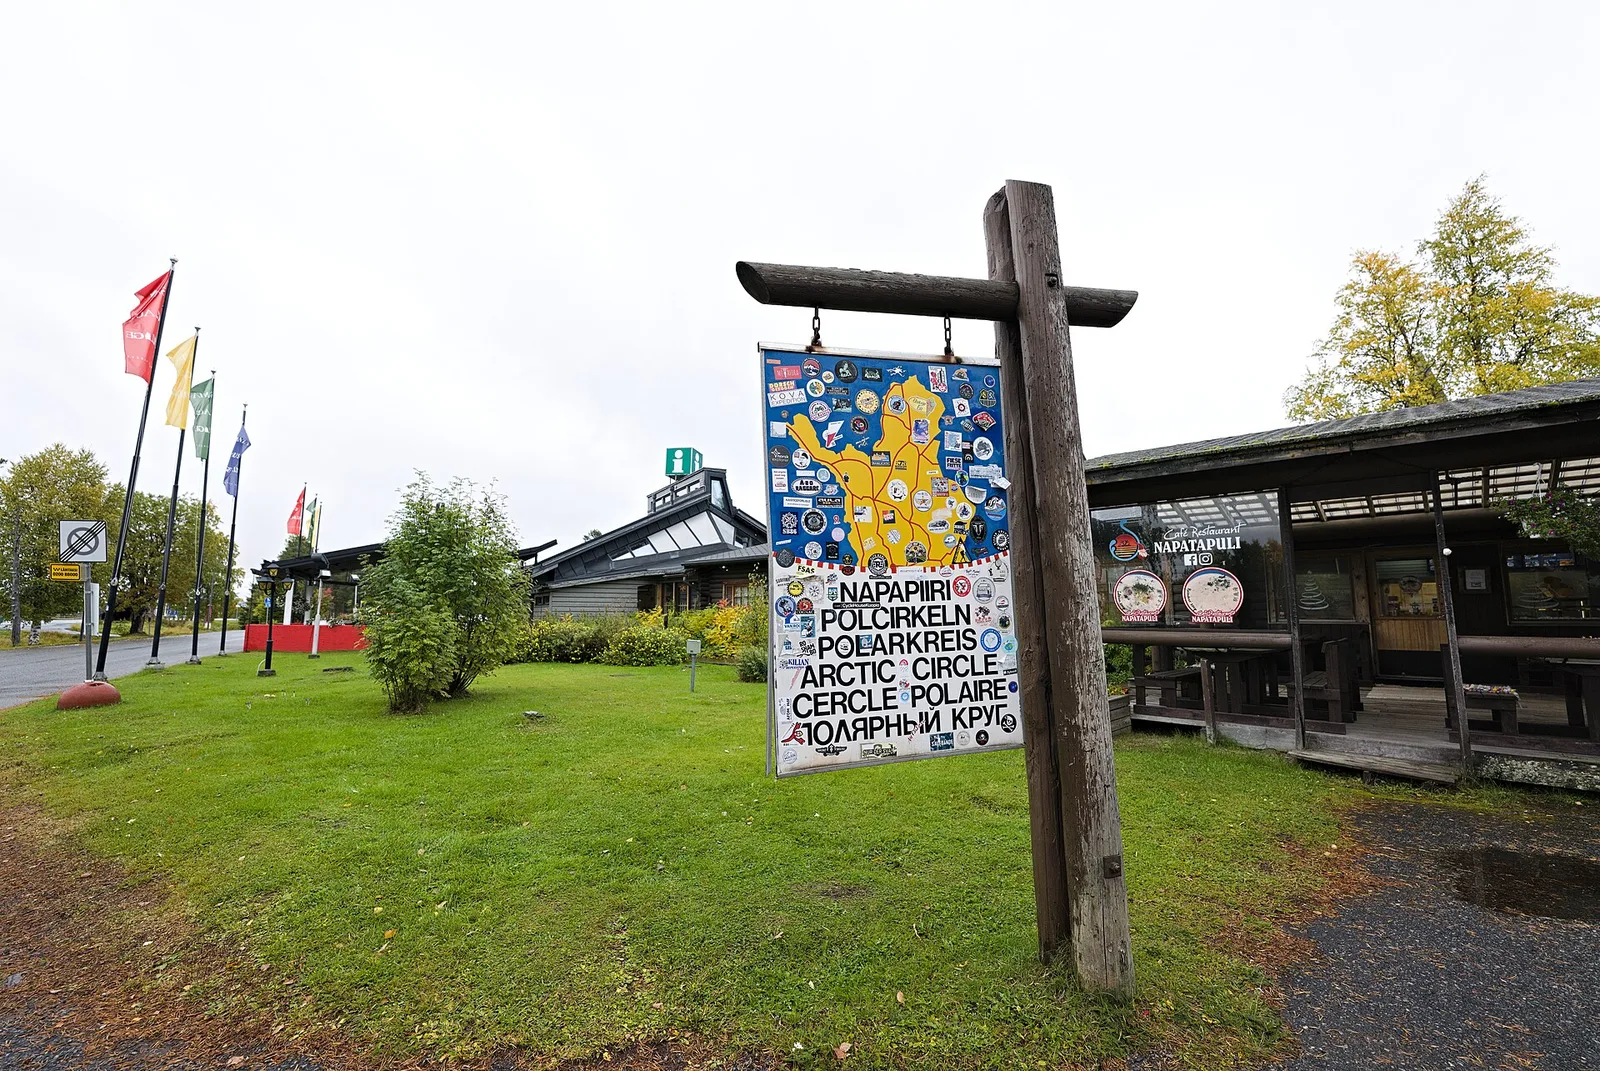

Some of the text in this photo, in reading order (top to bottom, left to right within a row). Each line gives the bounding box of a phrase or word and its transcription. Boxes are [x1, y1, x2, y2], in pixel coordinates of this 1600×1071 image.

[1153, 535, 1242, 554] NAPATAPULI
[1164, 522, 1247, 540] Café Restaurant
[797, 565, 815, 574] FSAS
[840, 579, 951, 603] NAPAPIIRI
[821, 604, 971, 632] POLCIRKELN
[818, 628, 977, 660] POLARKREIS
[800, 653, 999, 690] ARCTIC CIRCLE
[792, 687, 898, 719] CERCLE
[911, 678, 1008, 708] POLAIRE
[951, 704, 1008, 731] КРУГ
